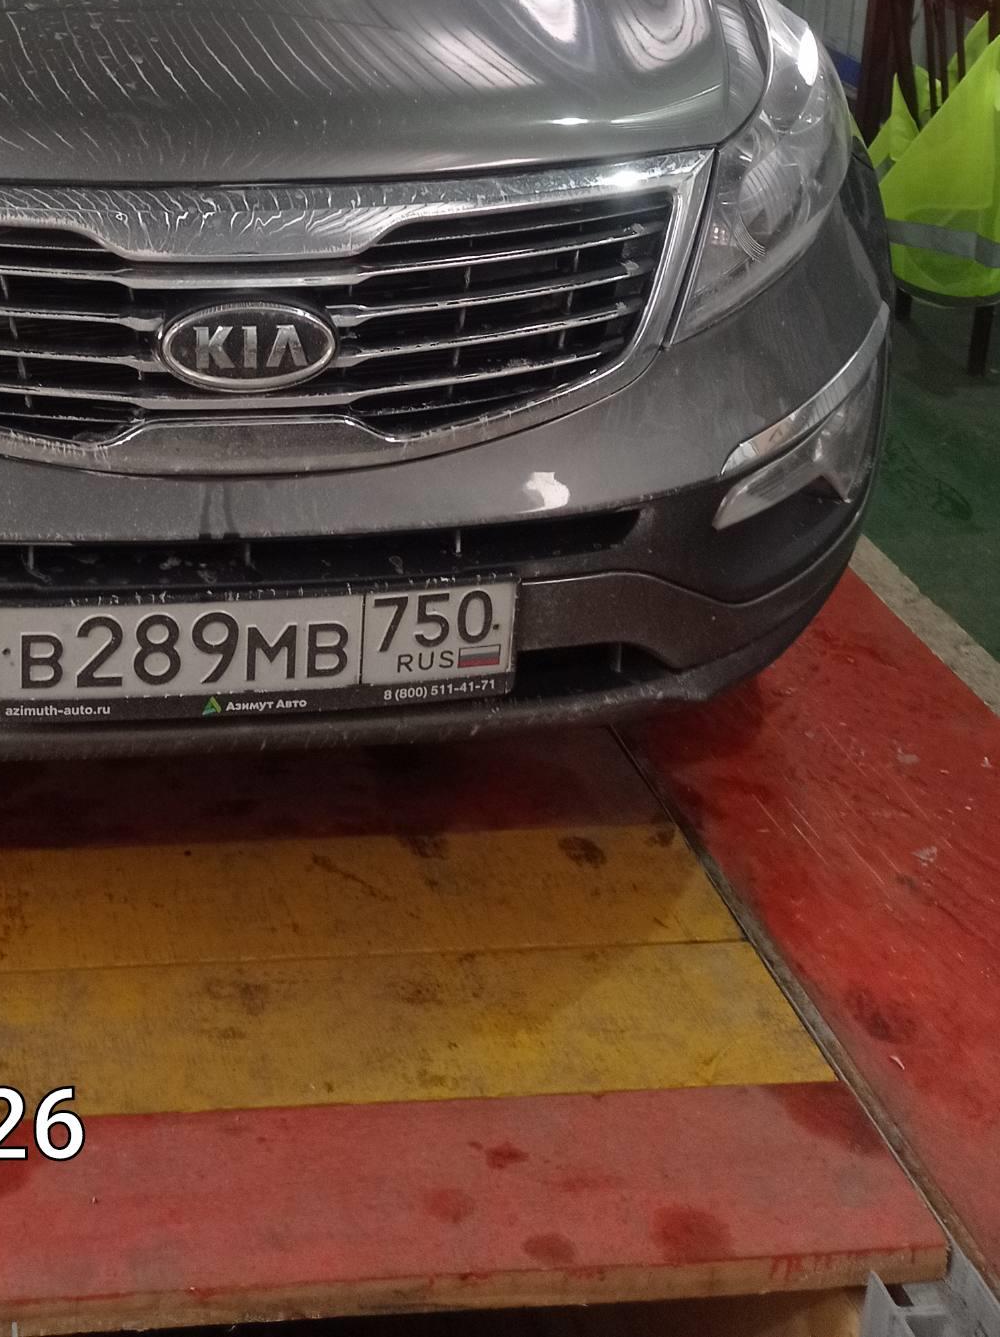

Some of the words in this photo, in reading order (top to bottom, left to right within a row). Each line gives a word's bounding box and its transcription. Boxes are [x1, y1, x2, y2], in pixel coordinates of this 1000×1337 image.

[193, 324, 308, 369] KIA
[374, 590, 493, 652] 750
[397, 650, 455, 673] RUS
[383, 689, 392, 701] 8
[394, 686, 428, 702] (800)
[430, 679, 496, 697] 511-41-71
[5, 704, 111, 717] azimuth-auto.ru
[225, 701, 274, 713] Азимут
[276, 697, 308, 710] Авто
